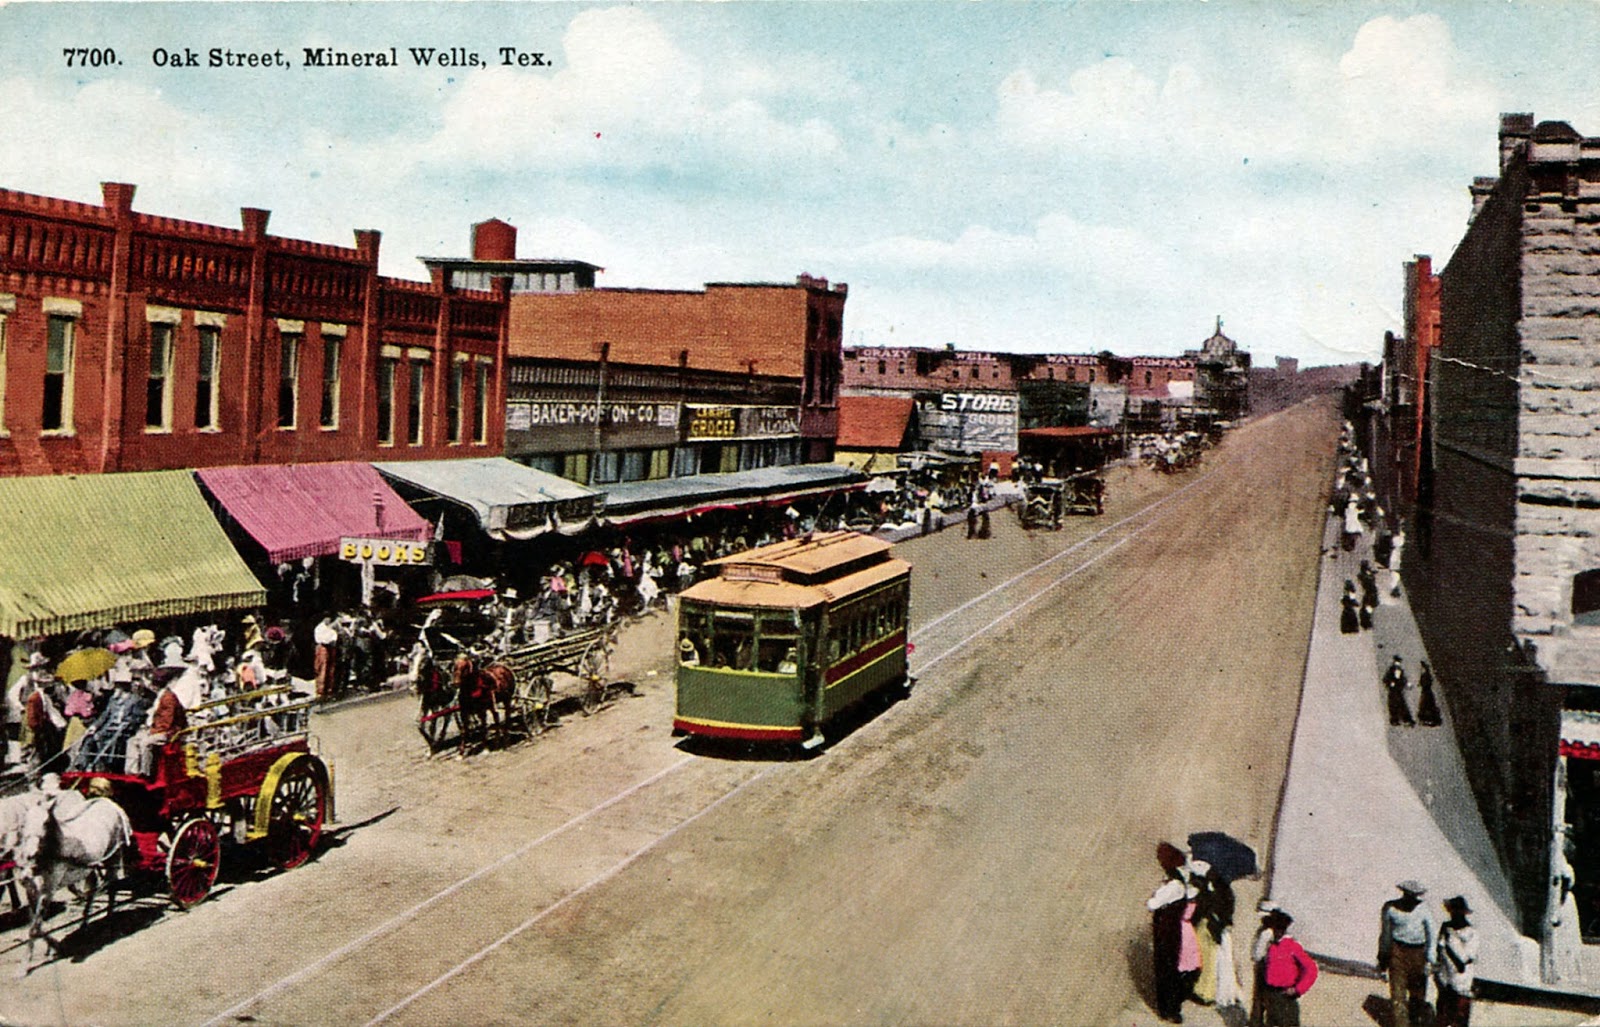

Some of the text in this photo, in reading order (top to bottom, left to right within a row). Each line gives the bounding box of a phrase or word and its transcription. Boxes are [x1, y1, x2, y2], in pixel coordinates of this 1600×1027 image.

[1046, 355, 1099, 366] WATER
[1132, 358, 1195, 369] COMPANY
[343, 543, 427, 563] BOOKS
